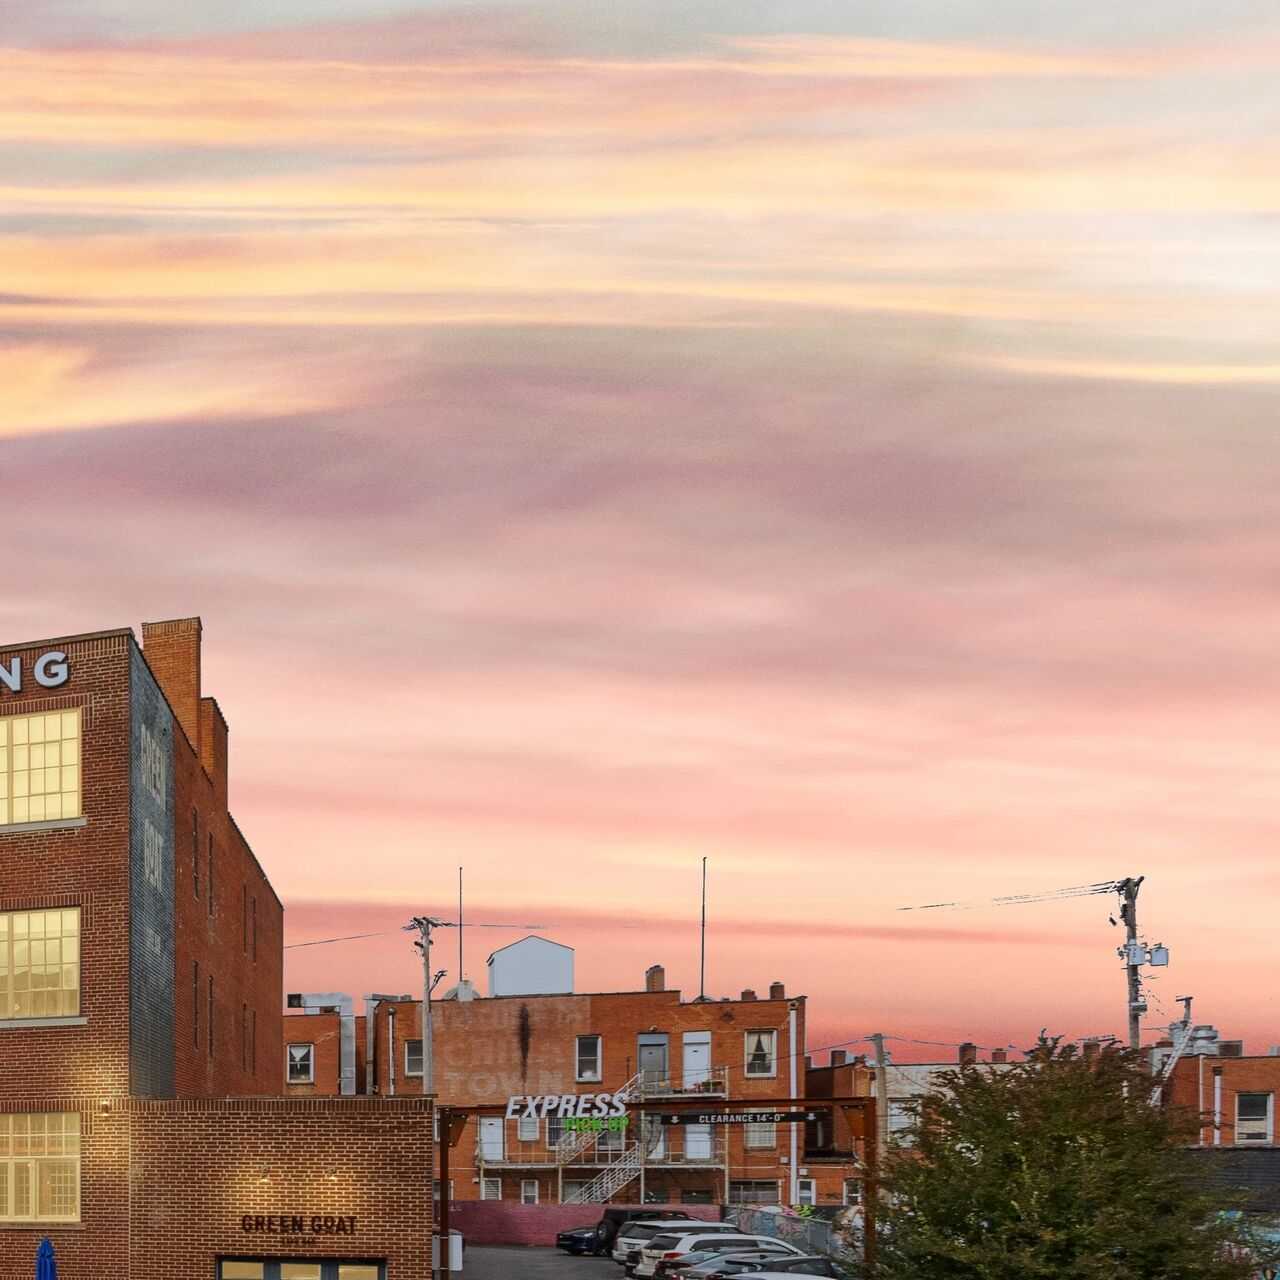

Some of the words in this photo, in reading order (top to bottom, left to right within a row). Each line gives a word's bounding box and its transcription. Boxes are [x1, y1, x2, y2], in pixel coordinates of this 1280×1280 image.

[505, 1092, 630, 1119] EXPRESS
[565, 1117, 602, 1132] PICK
[608, 1116, 630, 1132] UP
[699, 1114, 753, 1124] CLEARANCE
[242, 1215, 304, 1233] GREEN
[311, 1215, 358, 1234] GOAT
